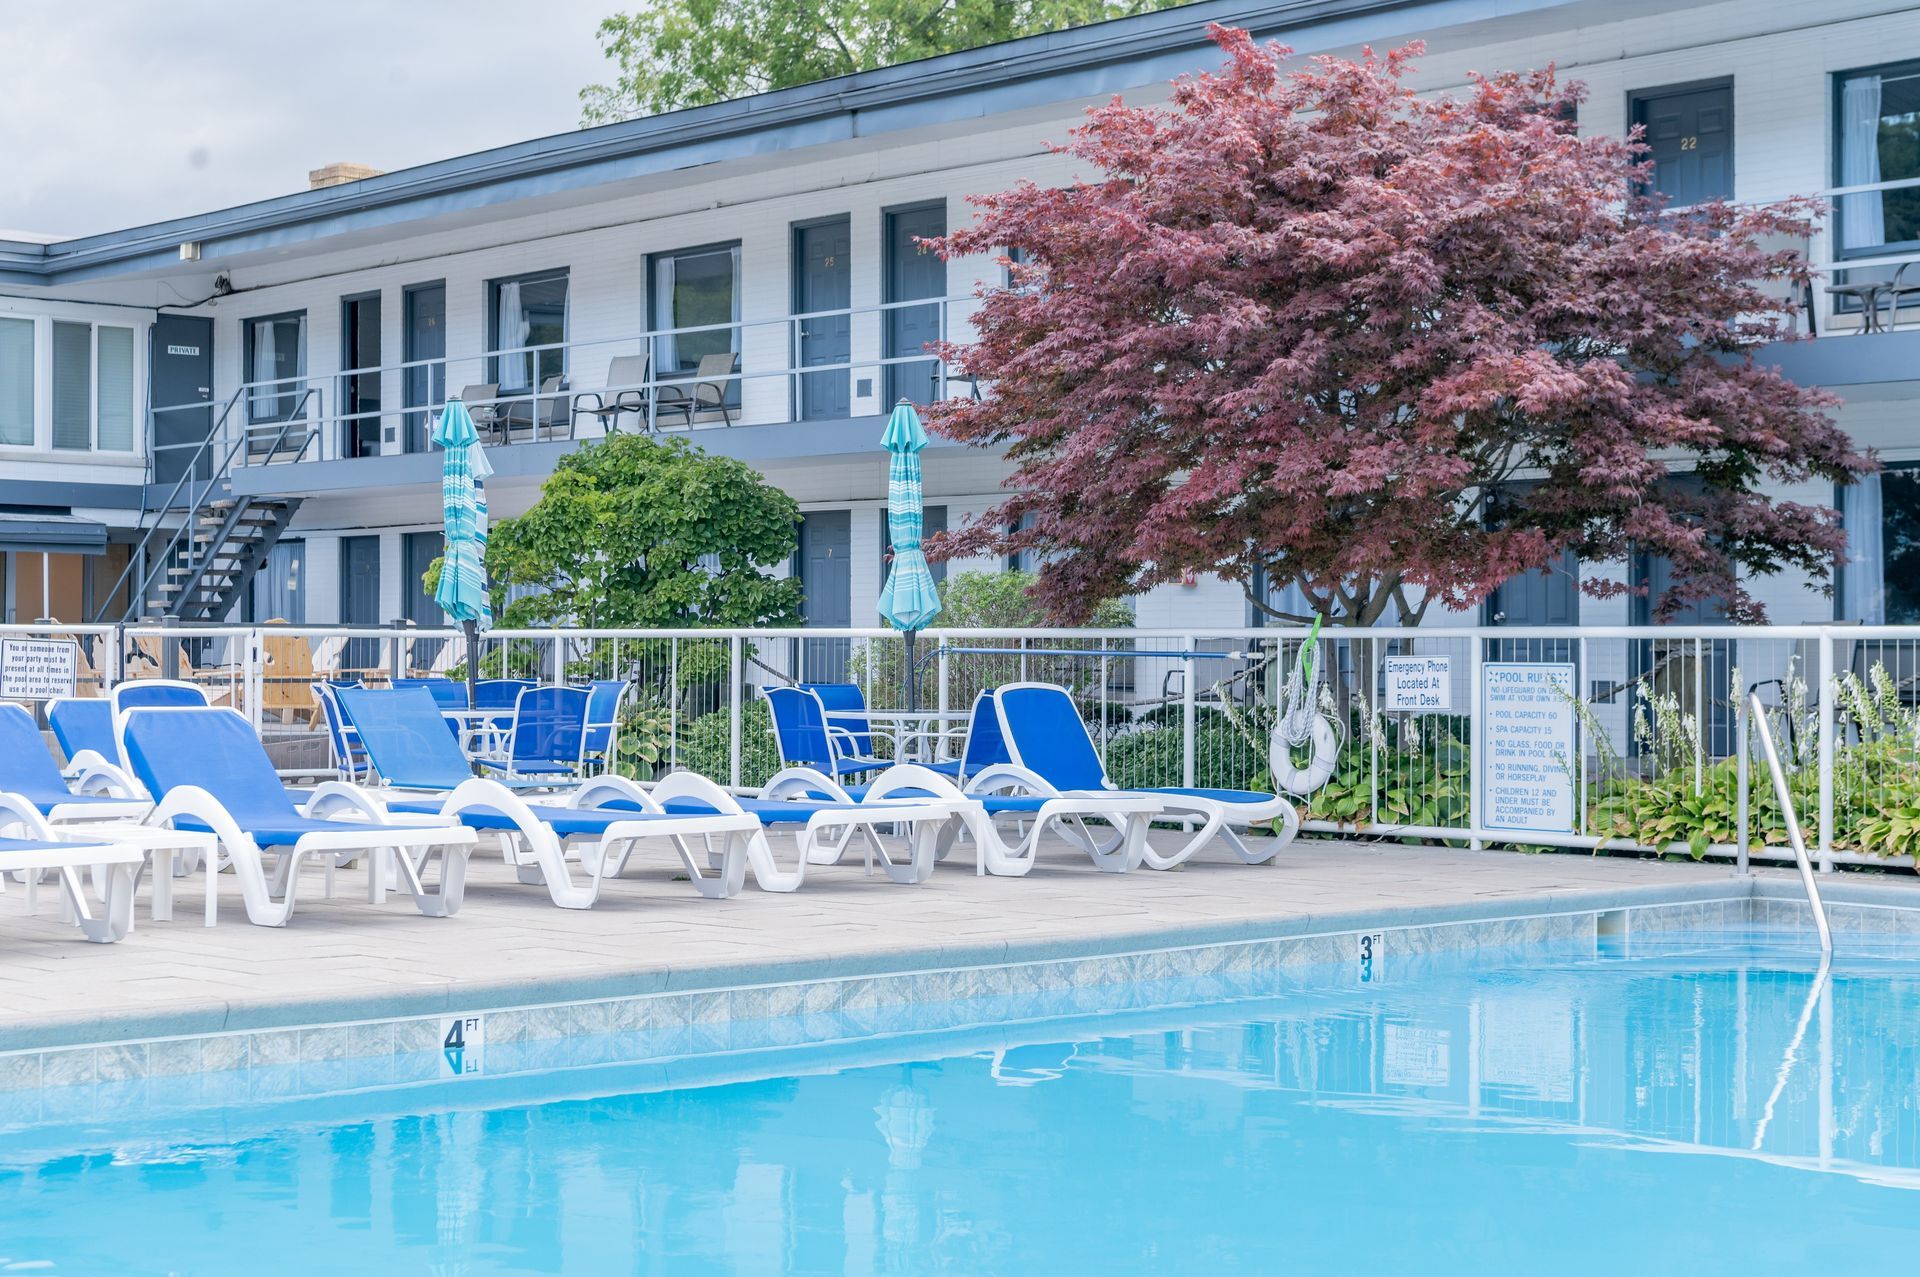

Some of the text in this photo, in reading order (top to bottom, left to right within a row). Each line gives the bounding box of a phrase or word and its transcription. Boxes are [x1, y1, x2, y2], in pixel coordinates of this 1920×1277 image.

[1681, 136, 1697, 150] 22
[170, 346, 196, 354] PRIVATE
[1388, 660, 1448, 675] Emergency Phone
[1397, 677, 1440, 688] Located At
[1500, 672, 1557, 684] POOL RUS
[1397, 694, 1440, 706] Front Desk
[1496, 710, 1514, 718] POOL
[1514, 711, 1546, 720] CAPACITY
[1496, 725, 1508, 733] SPA
[1510, 726, 1542, 734] CAPACITY
[1534, 741, 1552, 749] FOOD
[1556, 742, 1565, 750] OR
[1496, 748, 1516, 756] DRINK
[1528, 750, 1546, 758] POOL
[1550, 750, 1567, 758] AA
[1508, 774, 1546, 782] HORSEPLAY
[1496, 787, 1556, 797] CHILDREN 12 AND
[1496, 796, 1550, 806] UNDER MUST BE
[1496, 806, 1556, 816] ACCOMPANIED BY
[1508, 816, 1528, 824] ADULT
[1361, 934, 1381, 960] 3 FT
[444, 1018, 479, 1048] 4 FT
